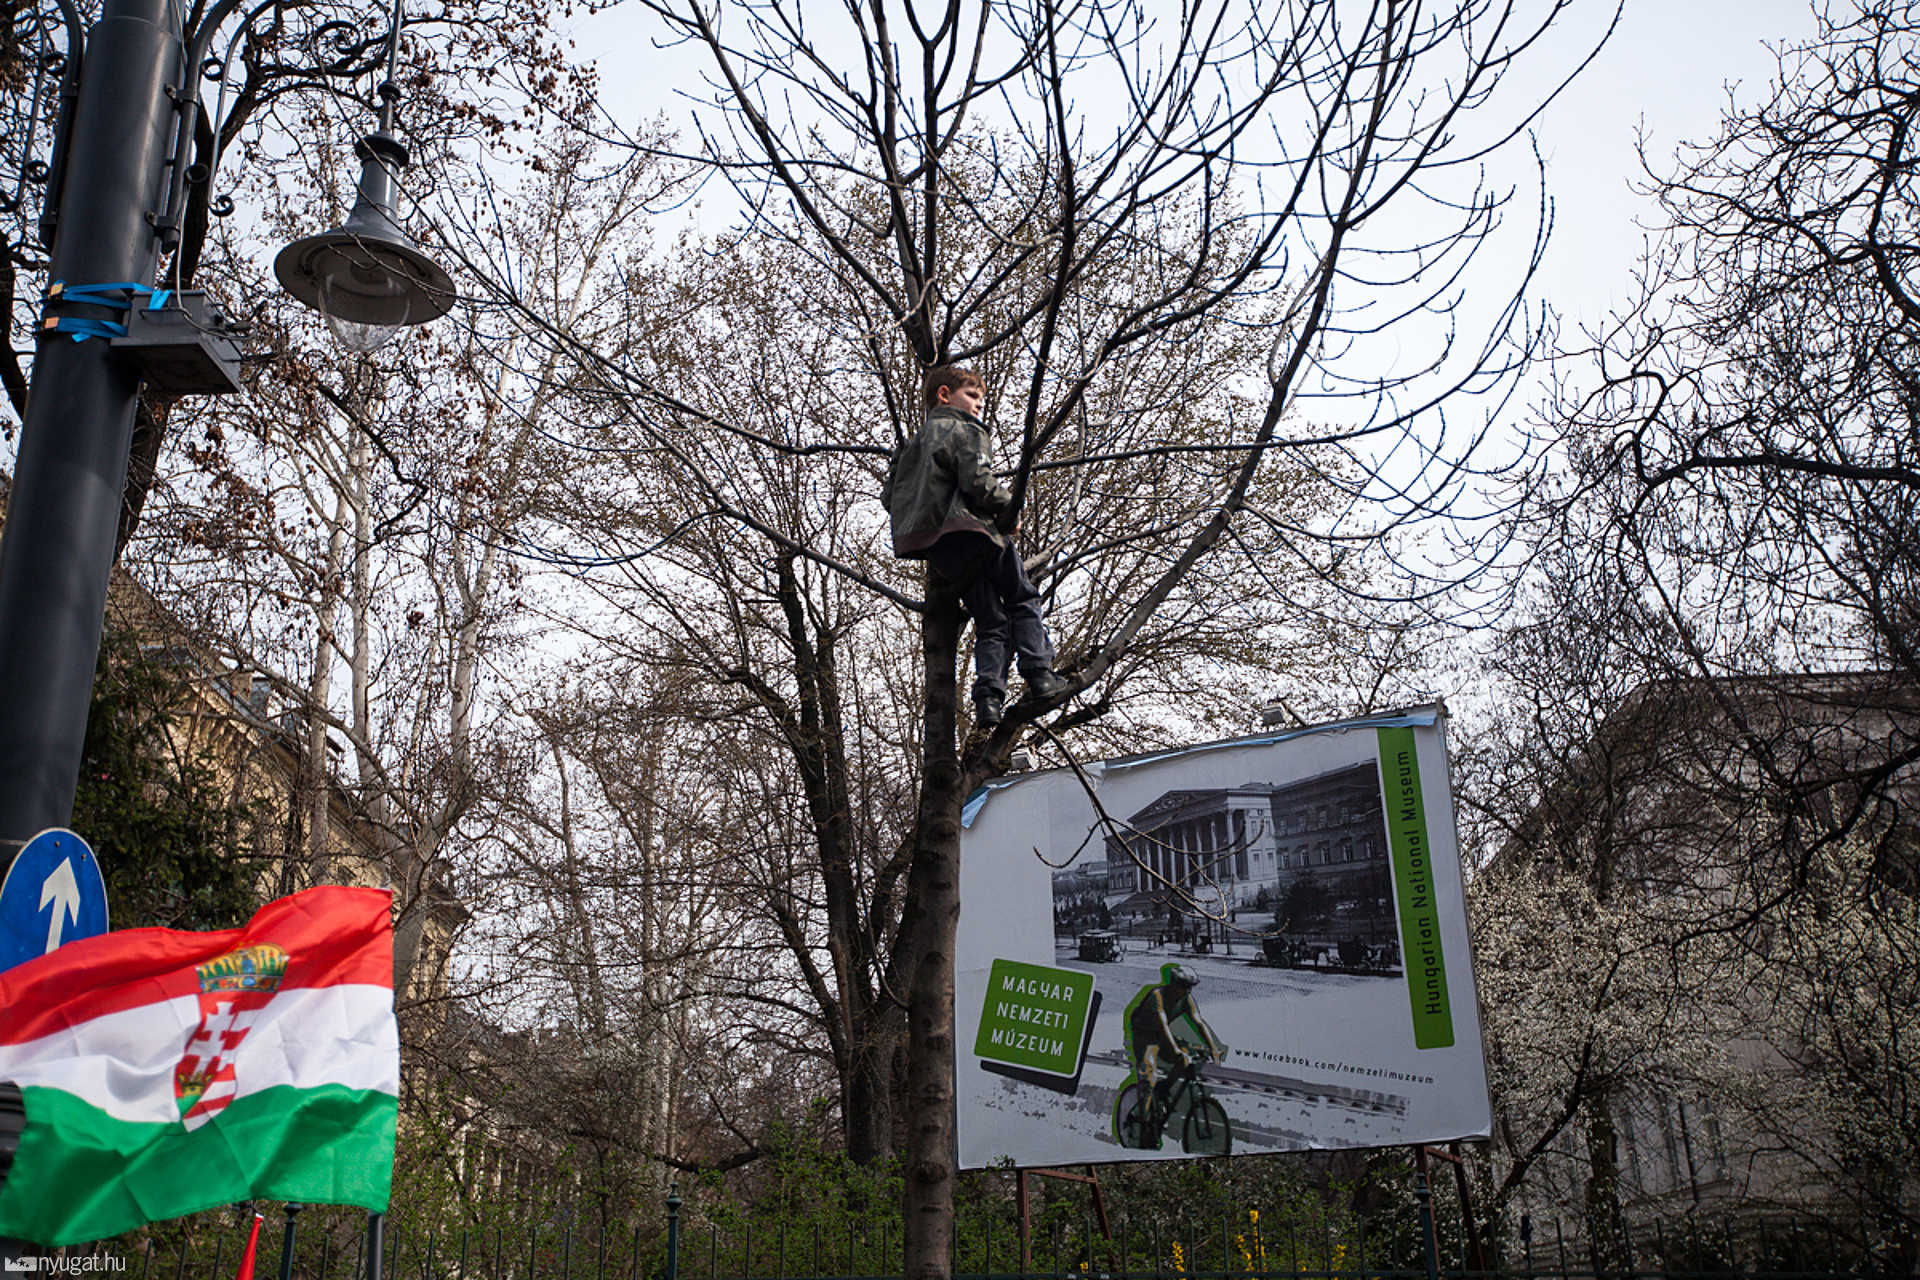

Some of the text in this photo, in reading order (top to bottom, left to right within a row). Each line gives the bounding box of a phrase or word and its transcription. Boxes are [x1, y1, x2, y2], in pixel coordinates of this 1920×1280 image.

[1397, 751, 1442, 1015] Hungarian National Museum
[1002, 975, 1074, 1002] MAGYAR
[996, 1001, 1069, 1029] NEMZETI
[991, 1028, 1064, 1057] MÚZEUM
[1235, 1049, 1434, 1084] www.facebook.com/nemzetimuzeum
